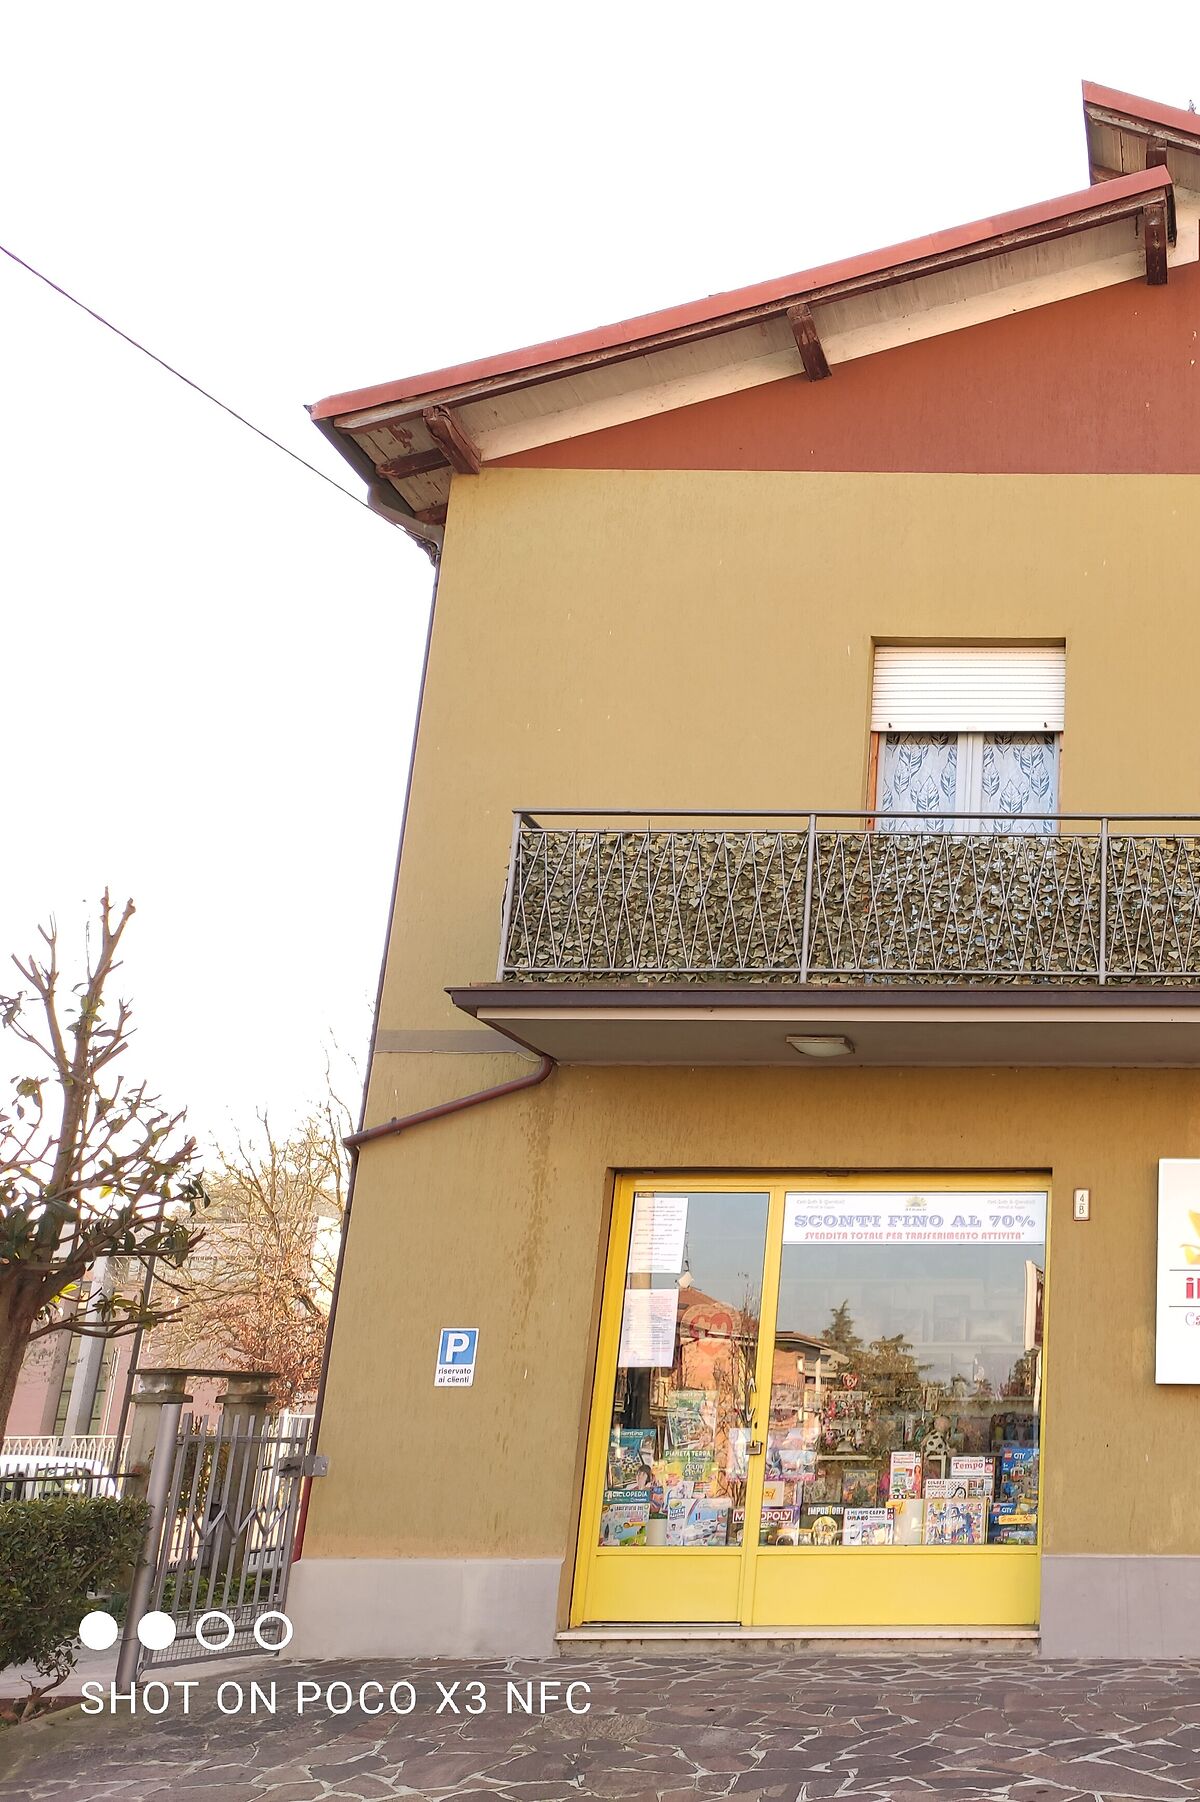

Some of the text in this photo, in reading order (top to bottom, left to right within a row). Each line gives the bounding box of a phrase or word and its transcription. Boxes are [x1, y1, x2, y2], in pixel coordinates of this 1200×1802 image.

[794, 1214, 1036, 1228] SCONTI FINO AL 70%
[804, 1231, 848, 1241] SVENDITA
[850, 1231, 884, 1241] TOTALE
[886, 1231, 902, 1241] PER
[905, 1231, 979, 1241] TRASFERIMENTO
[445, 1333, 470, 1363] P
[1014, 1452, 1026, 1460] CITY
[953, 1462, 984, 1470] Tempo
[735, 1511, 791, 1521] MOPOLY
